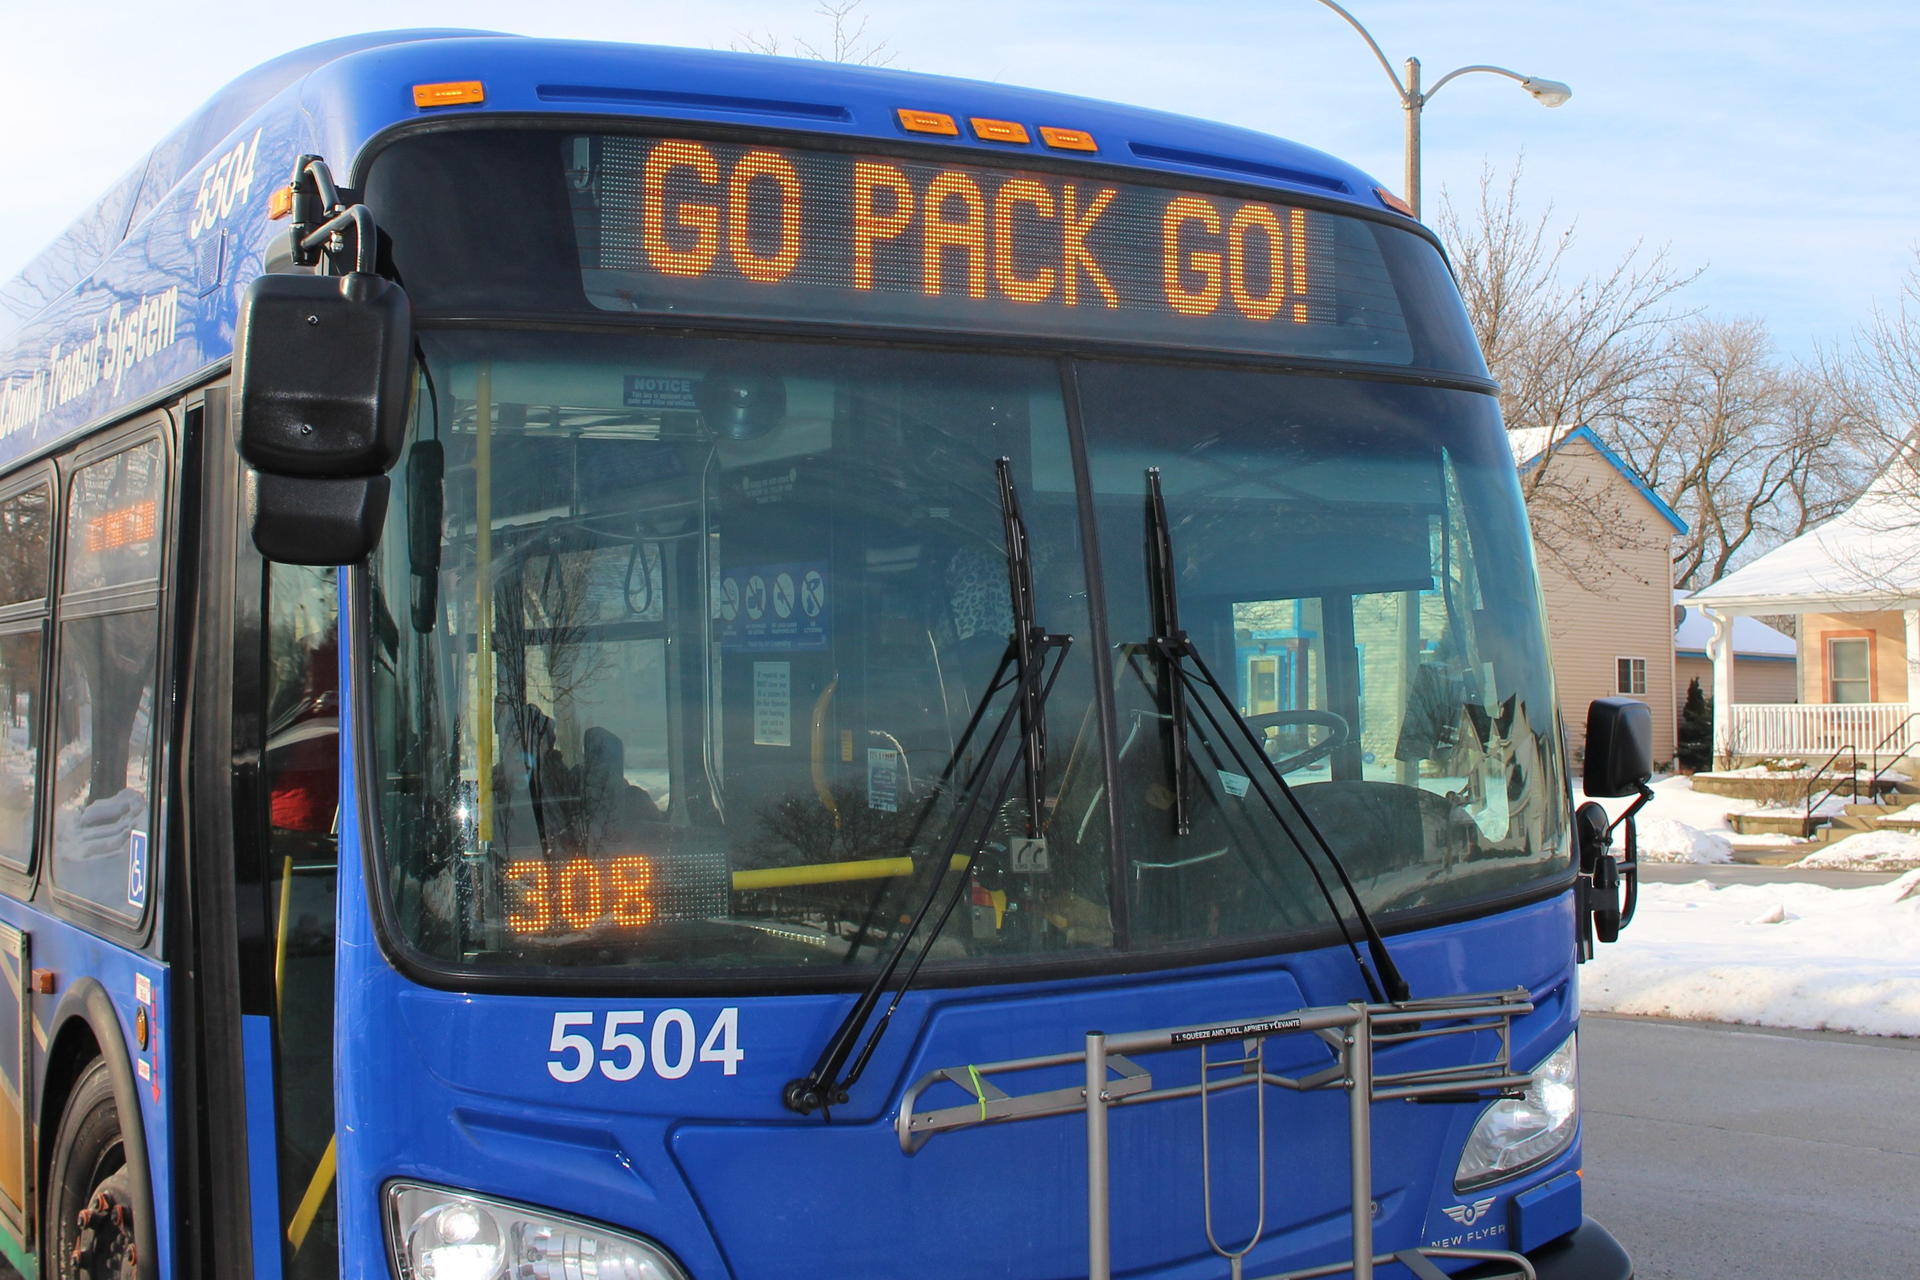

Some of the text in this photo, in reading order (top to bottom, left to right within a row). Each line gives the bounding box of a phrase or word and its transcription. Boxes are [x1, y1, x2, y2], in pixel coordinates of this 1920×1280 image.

[190, 127, 263, 240] 5504
[643, 140, 1309, 324] GO PACK GO!
[0, 285, 179, 440] County Transit System
[634, 378, 691, 392] NOTICE
[507, 856, 653, 933] 308
[546, 1006, 745, 1083] 5504
[1182, 1030, 1211, 1041] SQUEEZE
[1431, 1224, 1505, 1248] NEW FLYER
